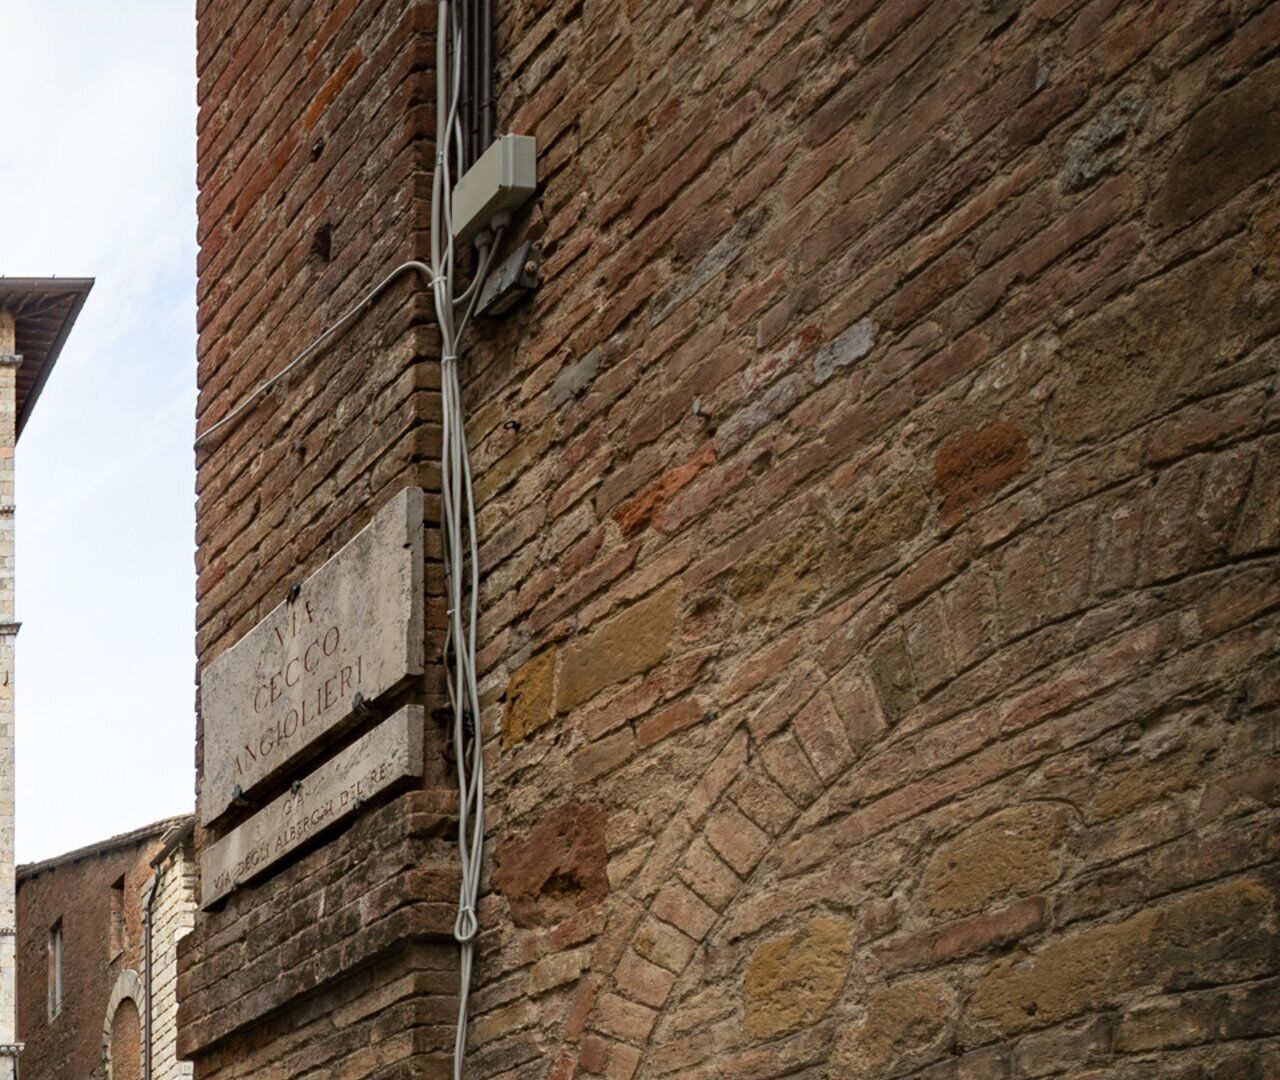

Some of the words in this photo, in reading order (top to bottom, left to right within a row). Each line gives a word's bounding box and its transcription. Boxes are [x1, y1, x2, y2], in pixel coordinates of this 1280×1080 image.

[274, 600, 314, 647] VIA
[253, 626, 340, 713] CECCO
[234, 655, 363, 775] ANGIOLIERI
